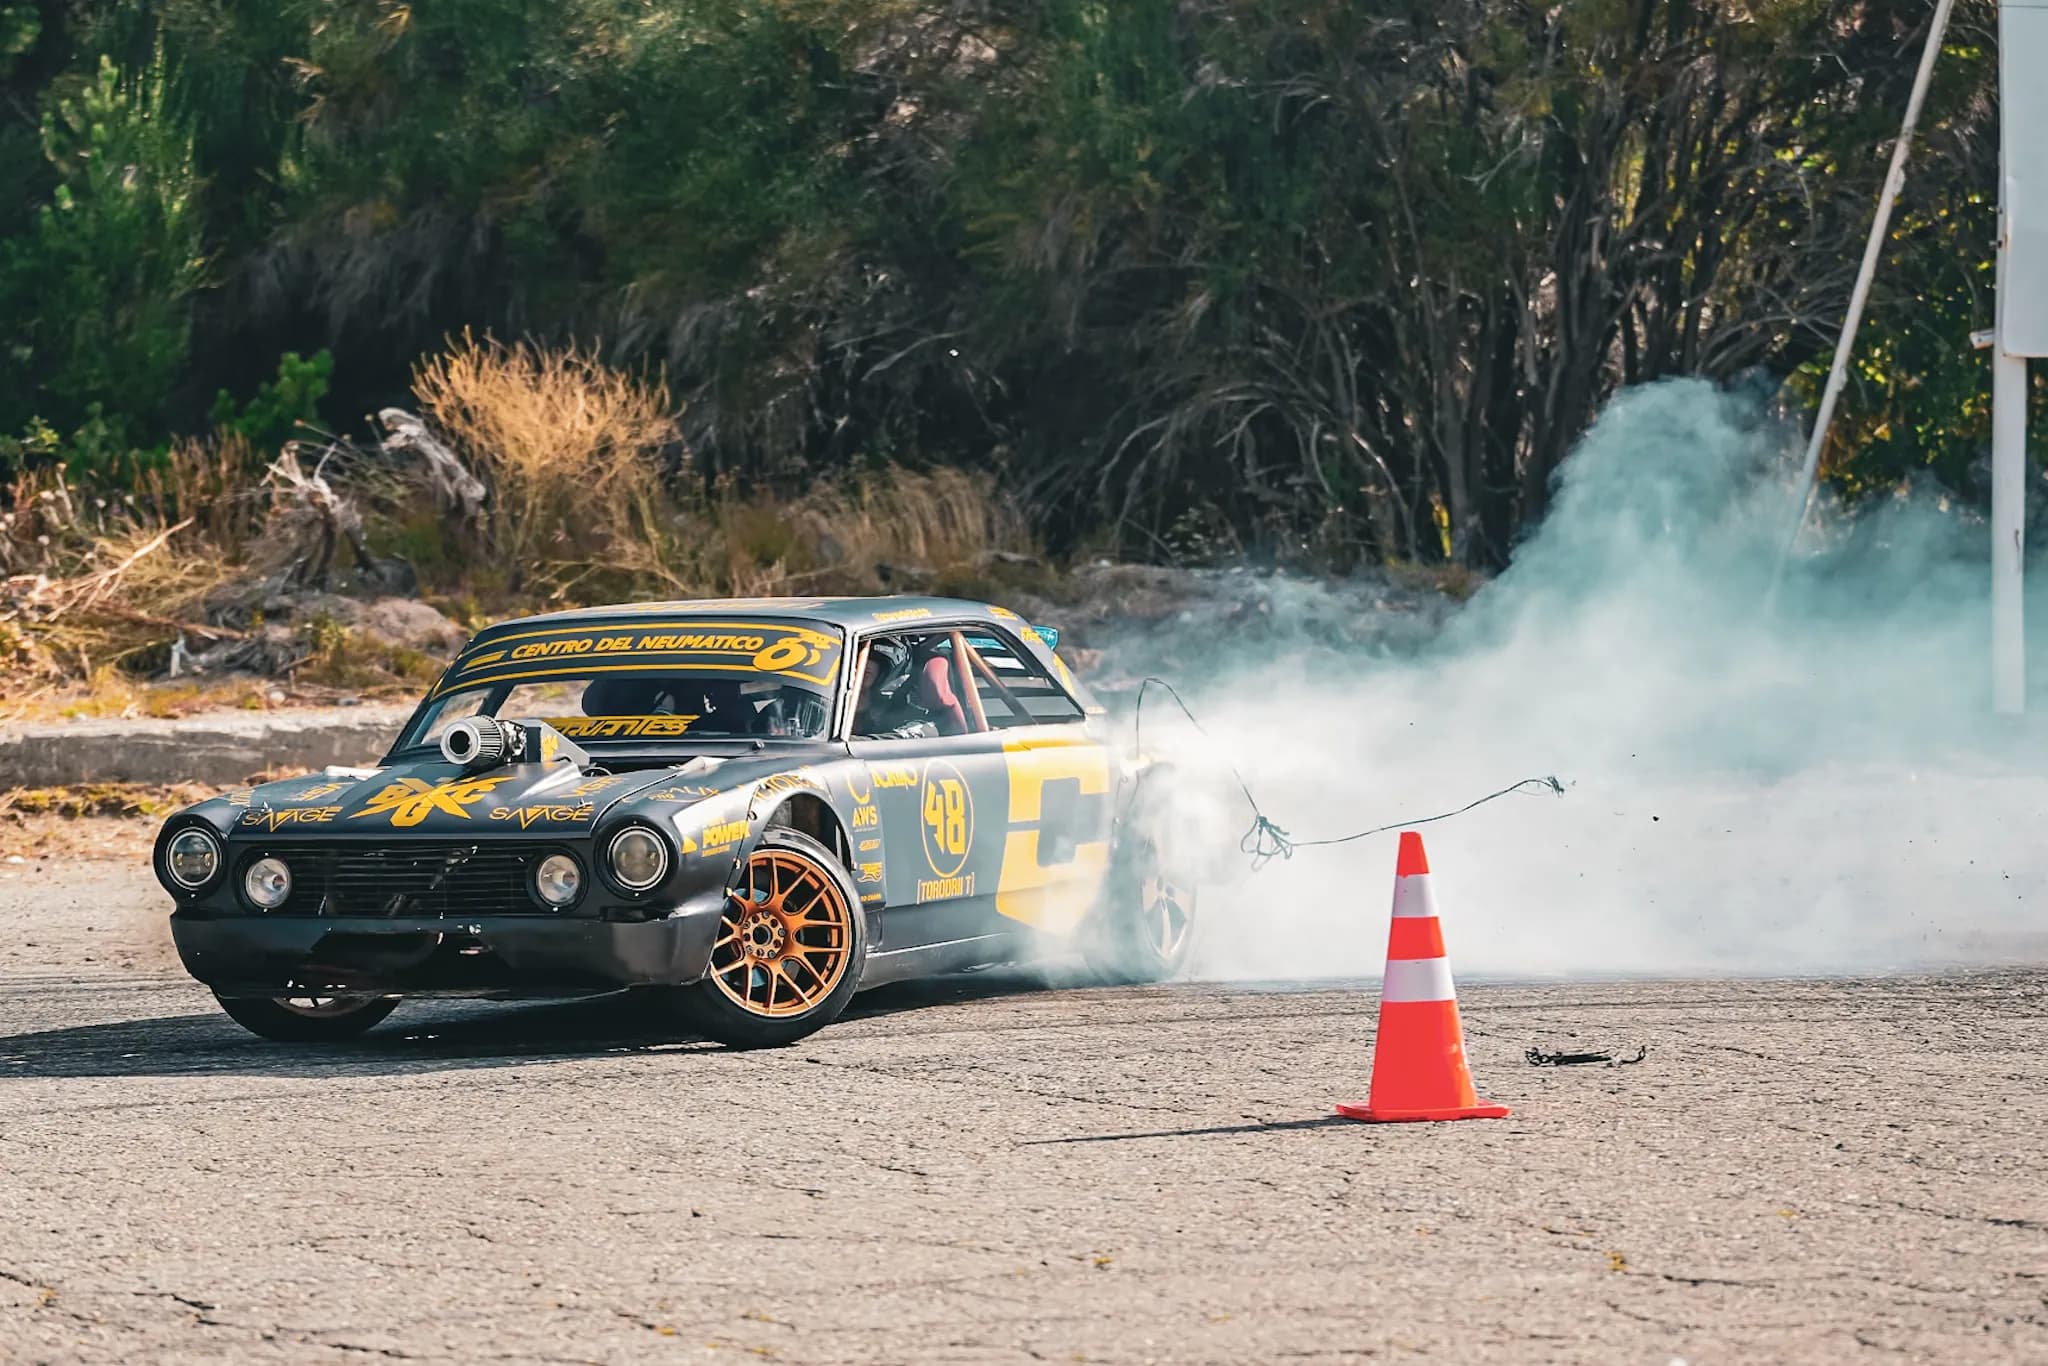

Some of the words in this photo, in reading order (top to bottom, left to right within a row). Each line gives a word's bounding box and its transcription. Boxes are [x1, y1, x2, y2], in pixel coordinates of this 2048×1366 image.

[511, 638, 593, 659] CENTRO
[594, 636, 634, 651] DEL
[636, 634, 764, 650] NEUMATICO
[242, 806, 343, 832] SAVAGE
[489, 805, 594, 830] SAVAGE
[852, 806, 878, 828] AWS
[924, 779, 965, 854] 48
[702, 820, 752, 849] POWER
